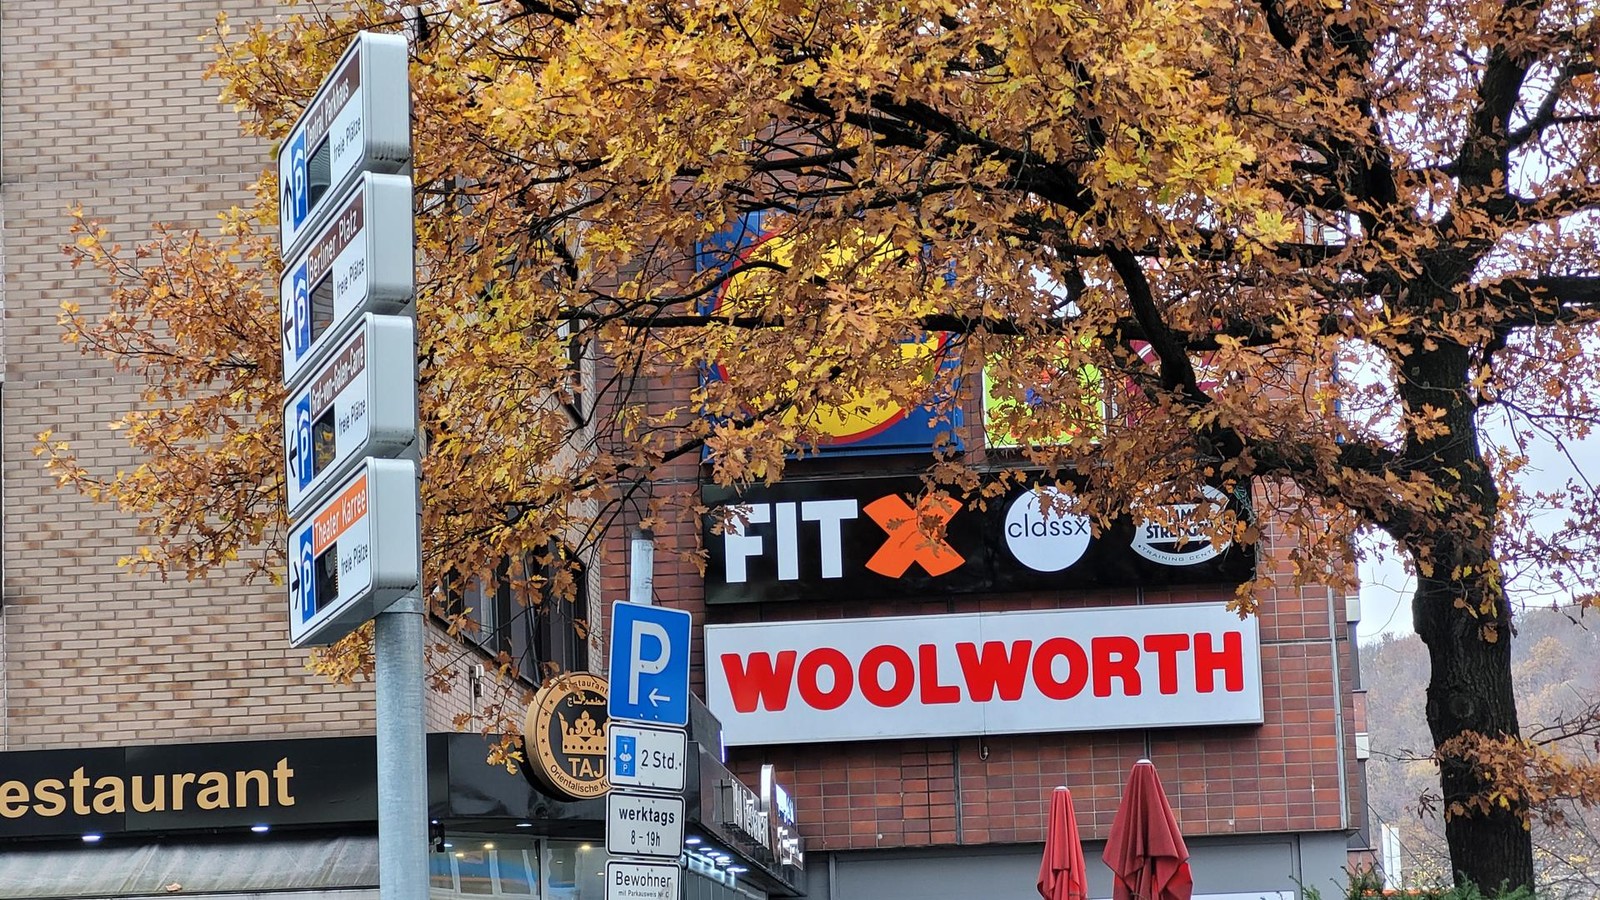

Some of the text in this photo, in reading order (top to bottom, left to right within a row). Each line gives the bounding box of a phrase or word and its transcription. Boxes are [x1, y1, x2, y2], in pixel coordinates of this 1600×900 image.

[306, 78, 349, 152] Zentral Parkhaus
[333, 117, 361, 162] freie Plätze
[294, 165, 304, 218] P
[308, 208, 358, 283] Berliner Platz
[336, 257, 365, 300] freie Plätze
[297, 296, 306, 353] P
[338, 399, 366, 438] freie Plätze
[301, 428, 309, 479] P
[314, 489, 367, 550] Theater Karree
[1007, 513, 1088, 538] classx
[340, 541, 368, 577] freie Plätze
[1141, 545, 1185, 562] TRAINING
[303, 560, 311, 611] P
[627, 618, 671, 706] P
[721, 631, 1244, 712] WOOLWORTH
[550, 764, 599, 793] Orientalische
[568, 757, 604, 778] TAJ
[641, 749, 678, 771] 2 Std.
[619, 806, 675, 826] werktags
[631, 830, 636, 845] 8
[646, 831, 661, 847] 19h
[616, 870, 671, 888] Bewohner
